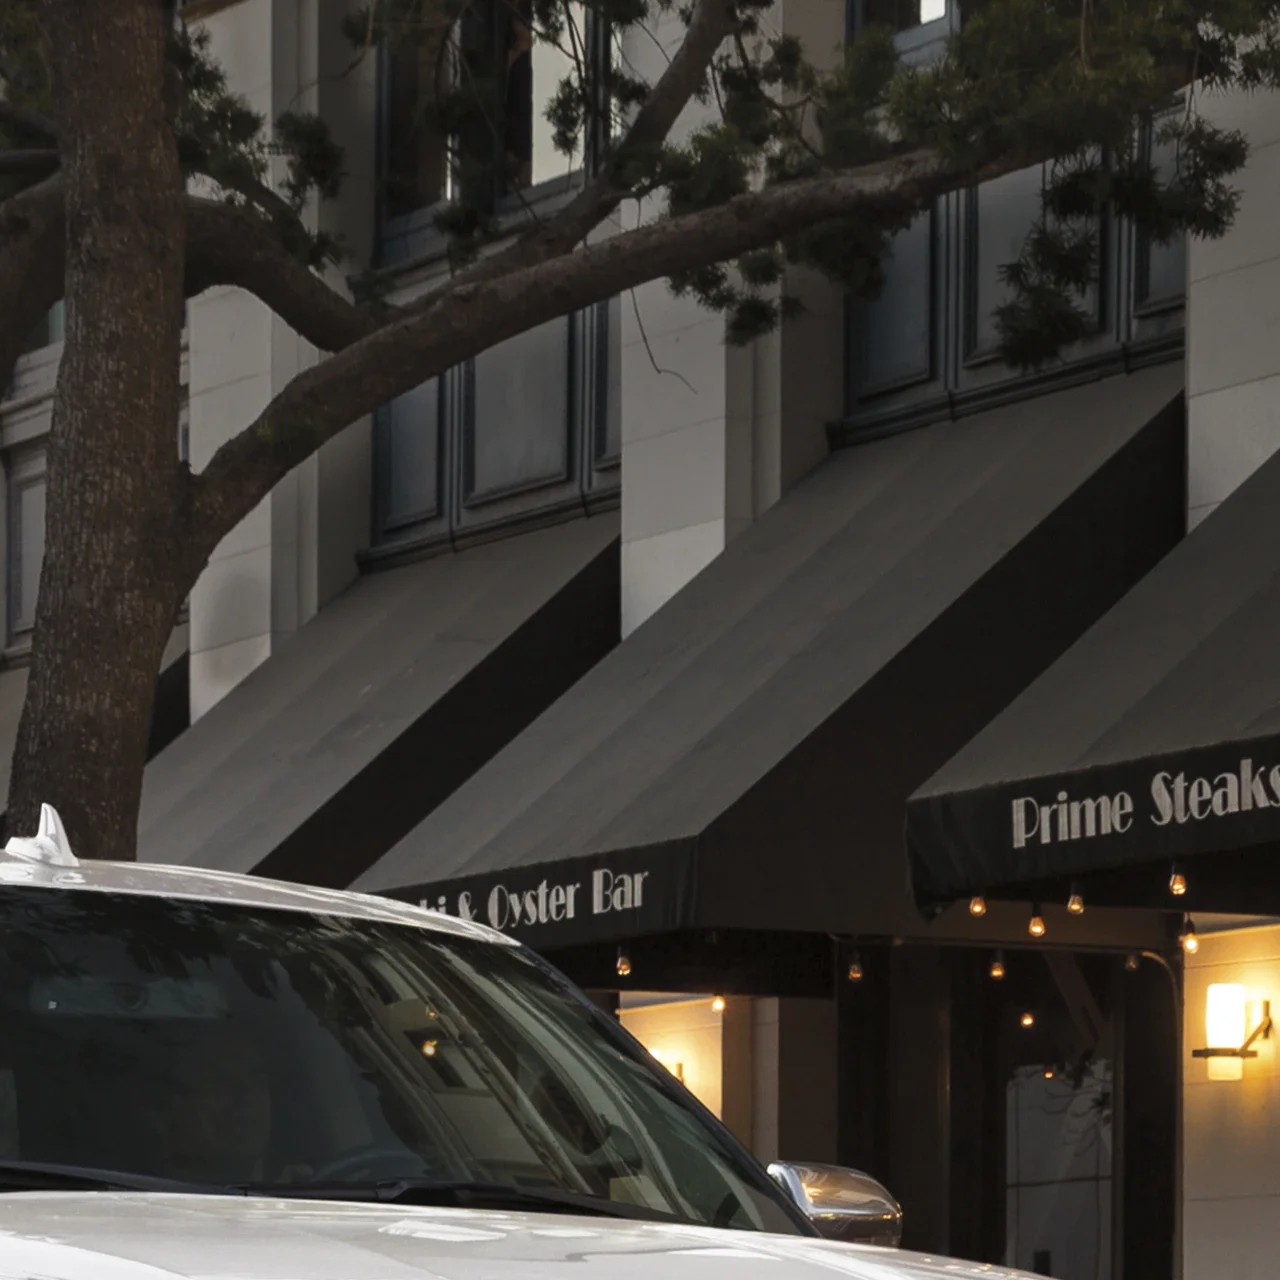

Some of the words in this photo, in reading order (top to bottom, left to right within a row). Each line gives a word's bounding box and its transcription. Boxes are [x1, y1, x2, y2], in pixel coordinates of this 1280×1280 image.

[1012, 791, 1133, 849] Prime
[487, 879, 581, 931] Oyster
[592, 868, 649, 914] Bar
